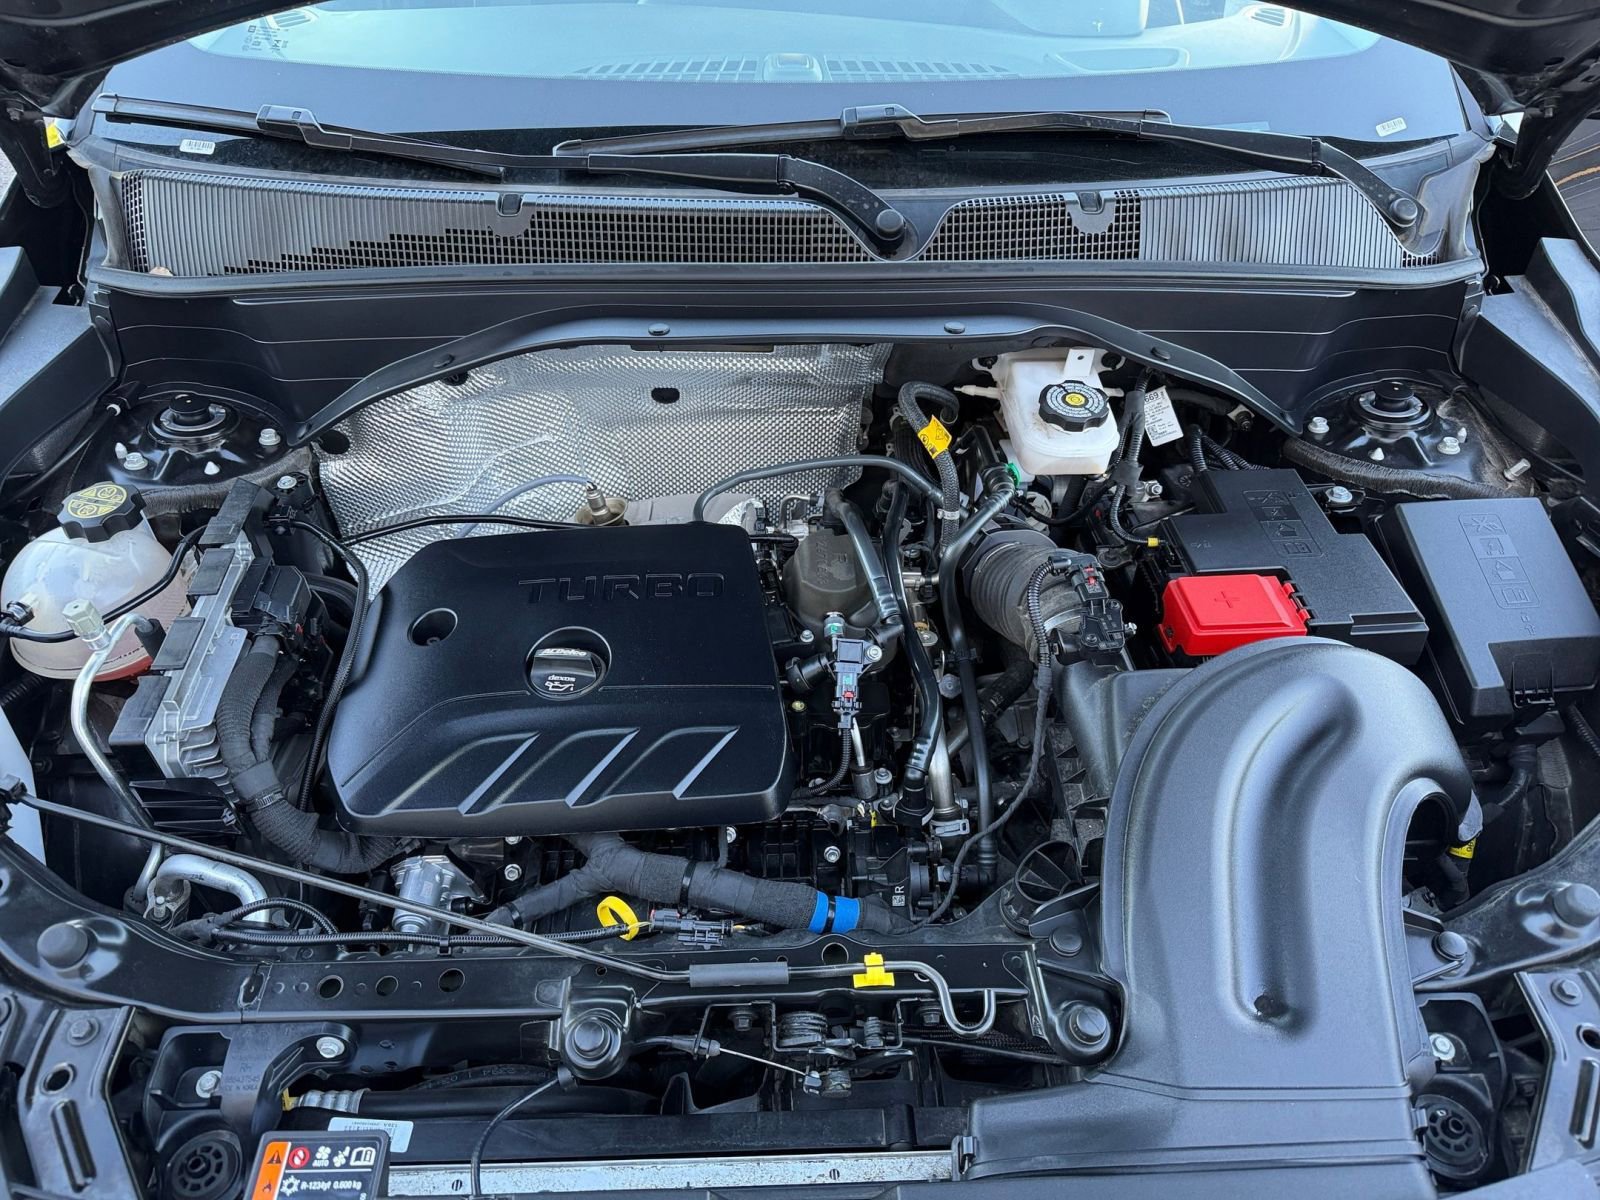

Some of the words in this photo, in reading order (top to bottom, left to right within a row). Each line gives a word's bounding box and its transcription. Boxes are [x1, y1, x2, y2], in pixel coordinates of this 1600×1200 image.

[519, 573, 725, 604] TURBO
[547, 674, 576, 682] dexos
[312, 1159, 330, 1168] AUTO
[353, 1180, 363, 1191] kg
